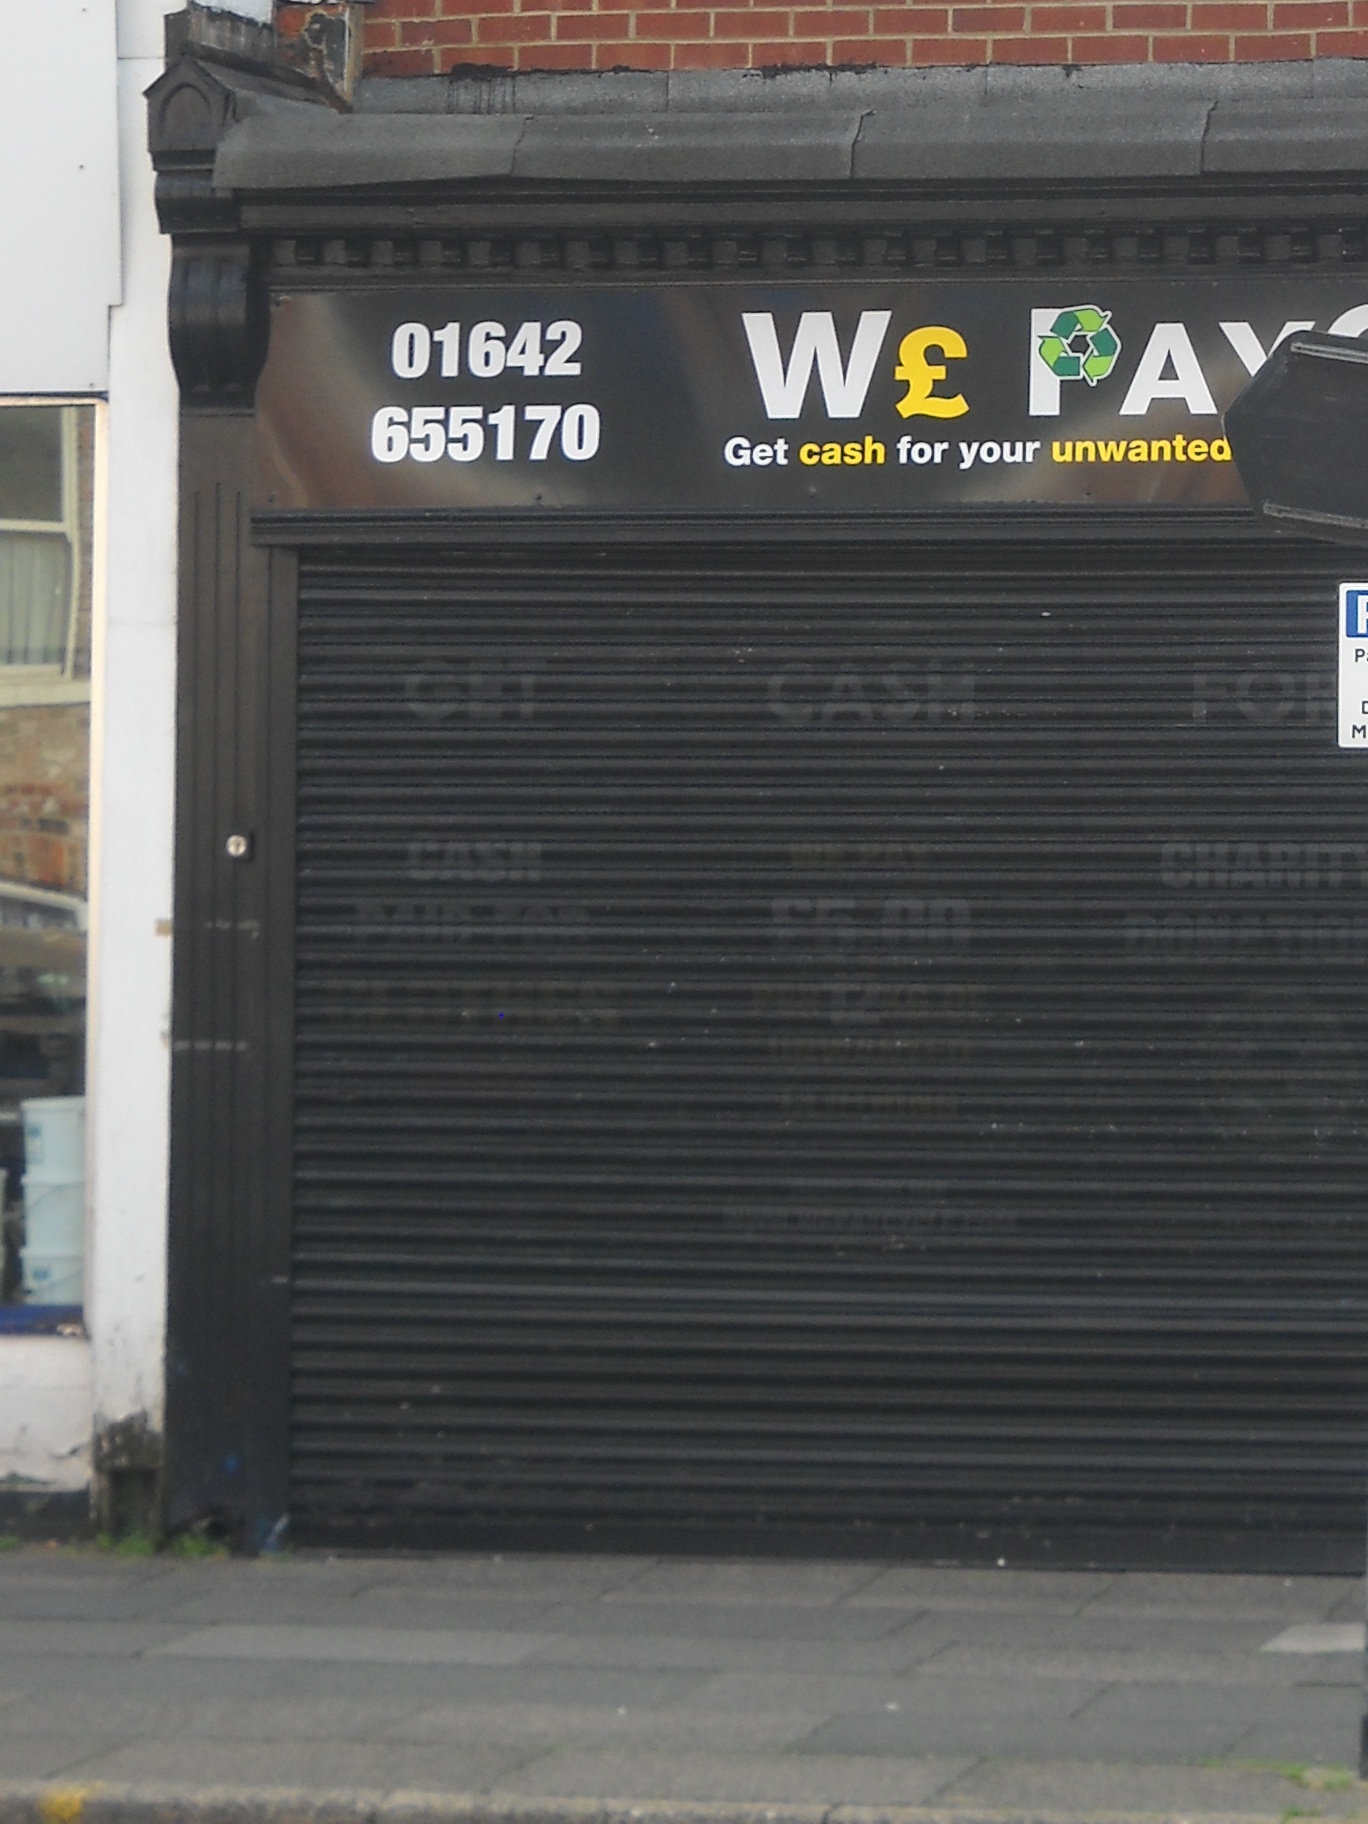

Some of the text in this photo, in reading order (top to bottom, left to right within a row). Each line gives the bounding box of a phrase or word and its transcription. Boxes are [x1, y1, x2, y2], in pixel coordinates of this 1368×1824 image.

[391, 321, 582, 378] 01642
[371, 404, 601, 463] 655170
[724, 437, 789, 467] Get
[800, 435, 886, 465] cash
[897, 435, 950, 465] for
[959, 440, 1041, 470] your
[1051, 433, 1233, 463] unwanted
[405, 658, 548, 725] GET
[766, 659, 977, 727] CASH
[407, 833, 542, 883] CASH
